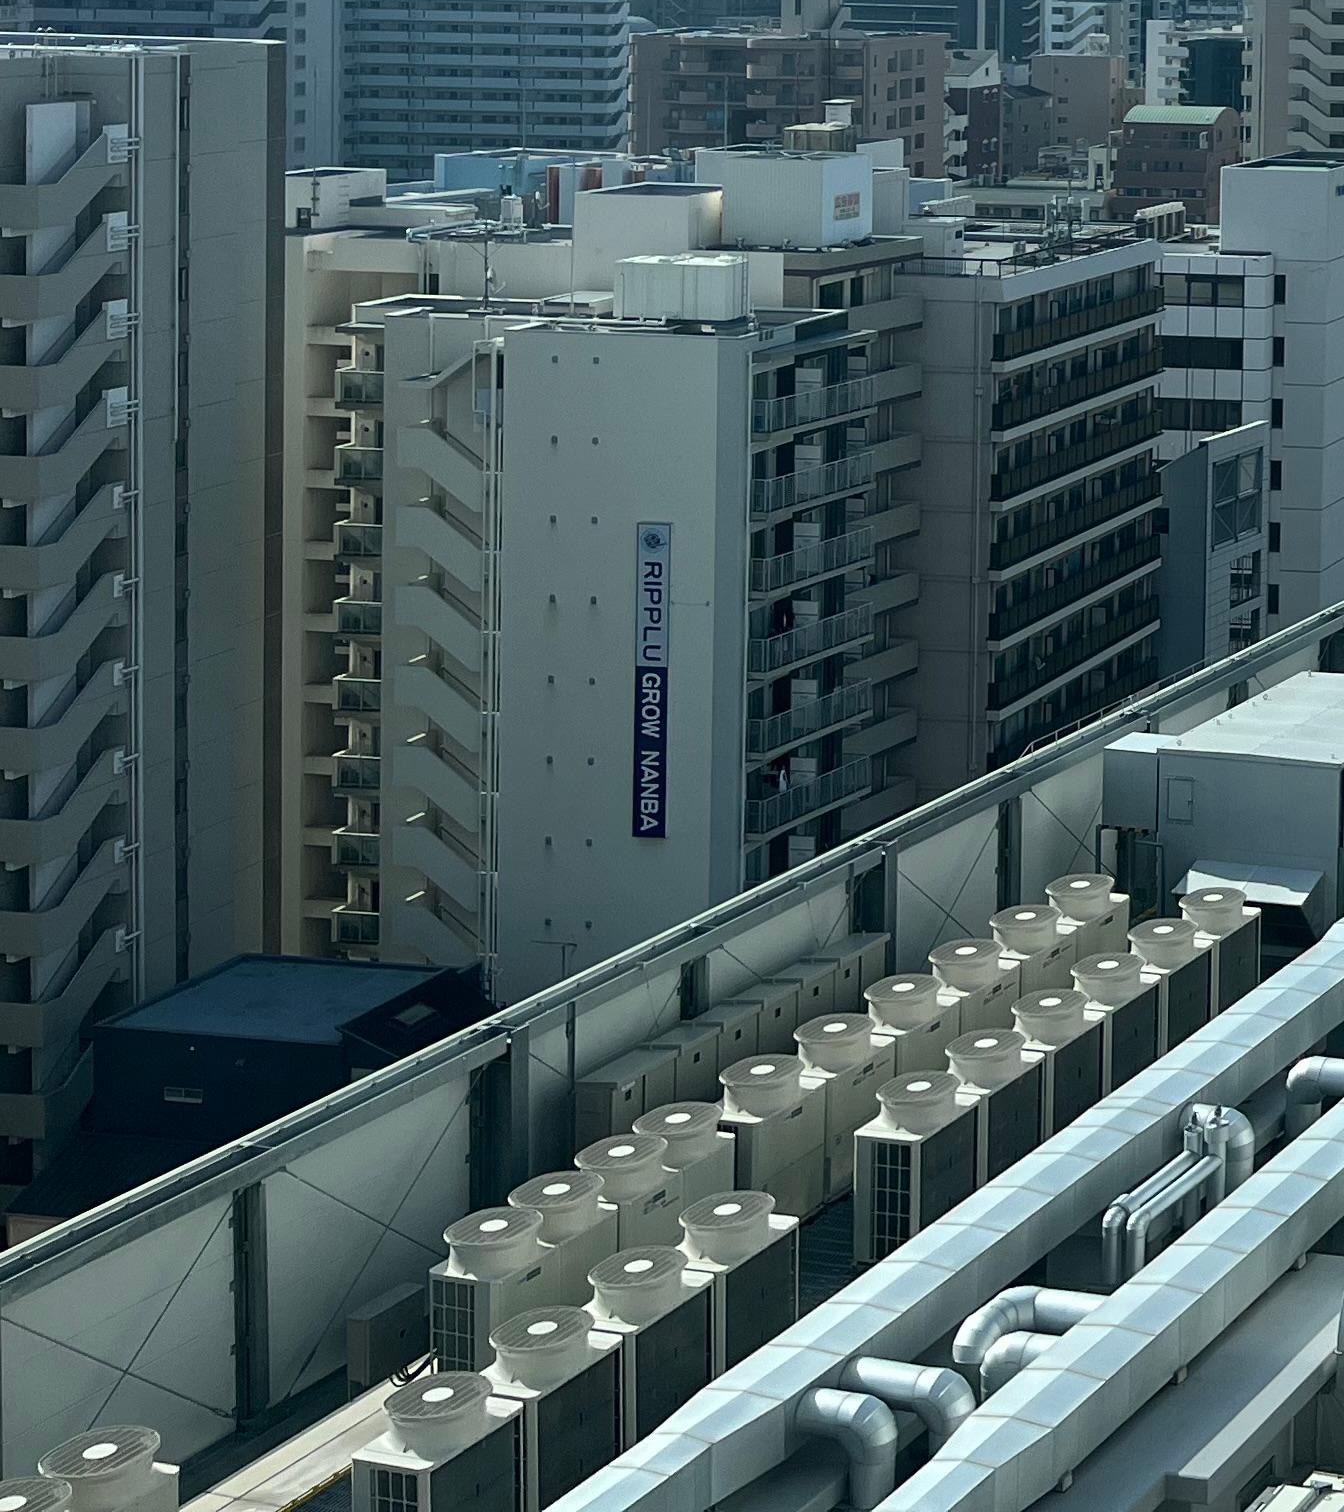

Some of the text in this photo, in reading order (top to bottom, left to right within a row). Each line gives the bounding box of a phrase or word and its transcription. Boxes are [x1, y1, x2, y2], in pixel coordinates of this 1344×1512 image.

[639, 561, 663, 831] RIPPLU GROW NANBA
